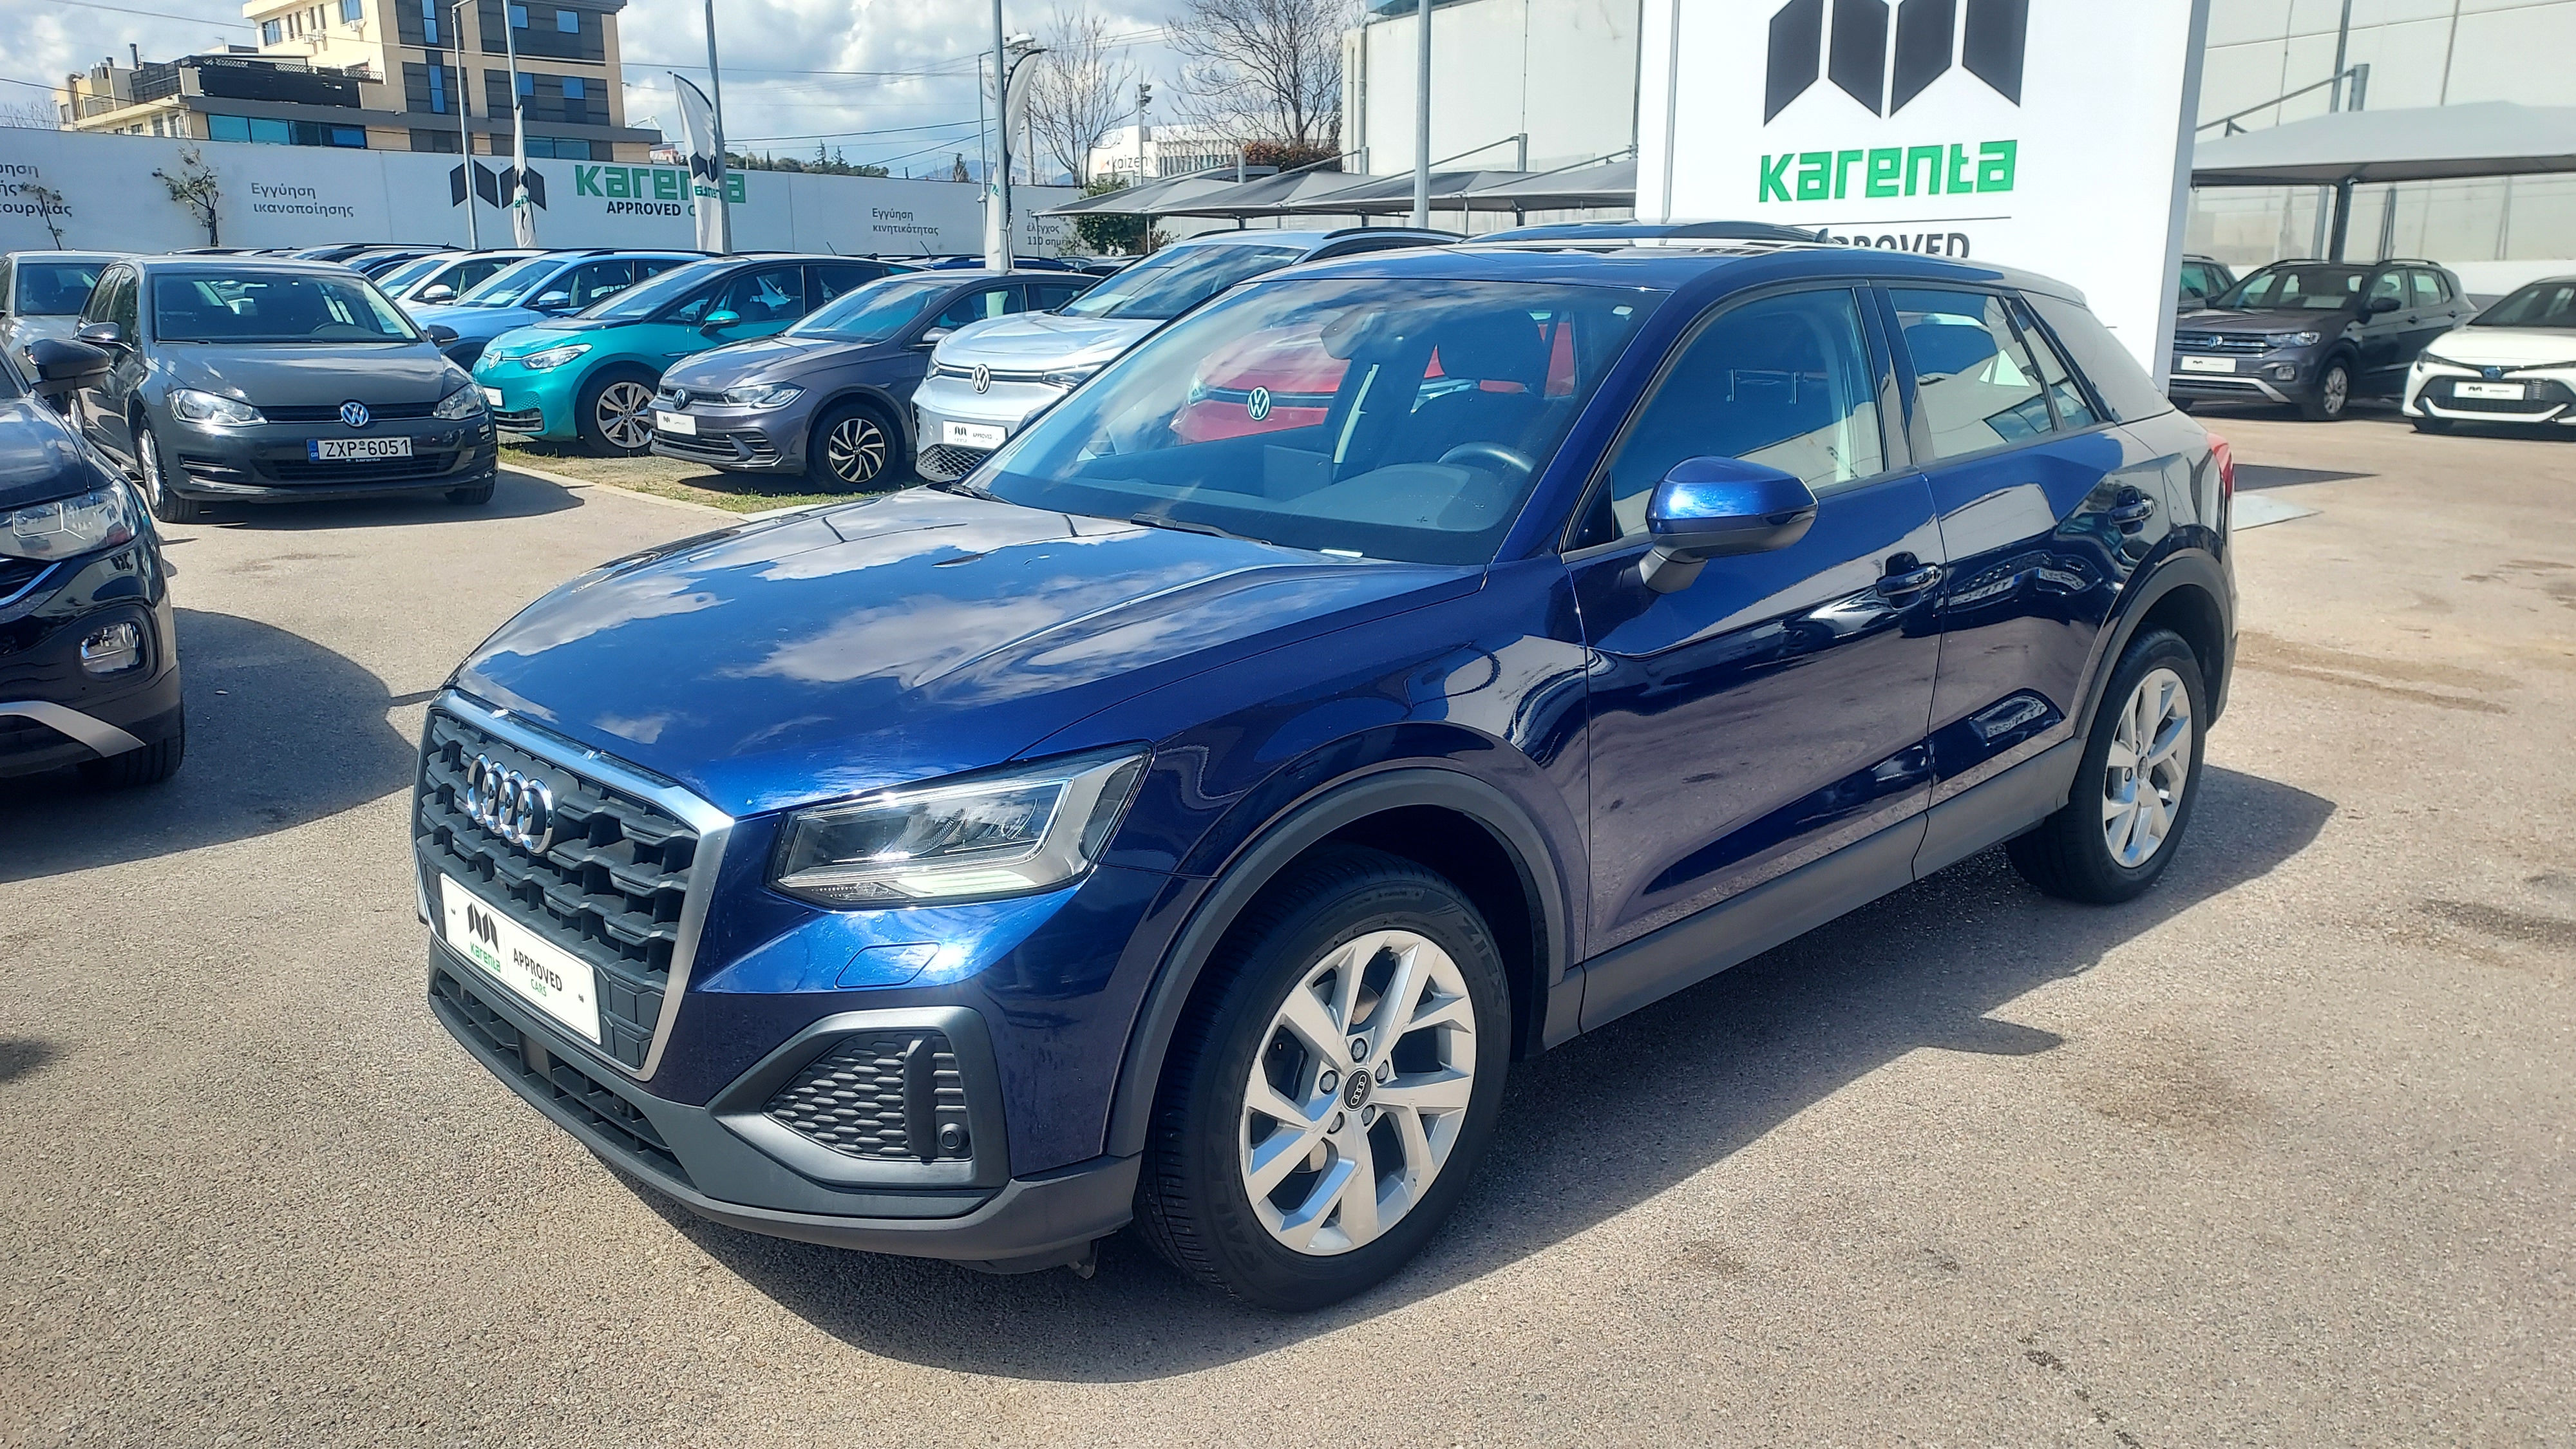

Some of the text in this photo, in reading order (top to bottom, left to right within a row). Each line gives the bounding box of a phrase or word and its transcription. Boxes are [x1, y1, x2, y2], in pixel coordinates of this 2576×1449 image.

[1112, 155, 1148, 169] kaizen
[251, 182, 316, 199] Εγγύηση
[0, 201, 72, 218] ουργίας
[253, 202, 354, 218] ικανοποίησης
[607, 201, 681, 216] APPROVED
[872, 207, 913, 222] Εγγύηση
[873, 223, 939, 236] κινητικότητας
[1027, 236, 1043, 245] 110
[513, 947, 562, 992] APPROVED
[531, 978, 547, 997] CARS
